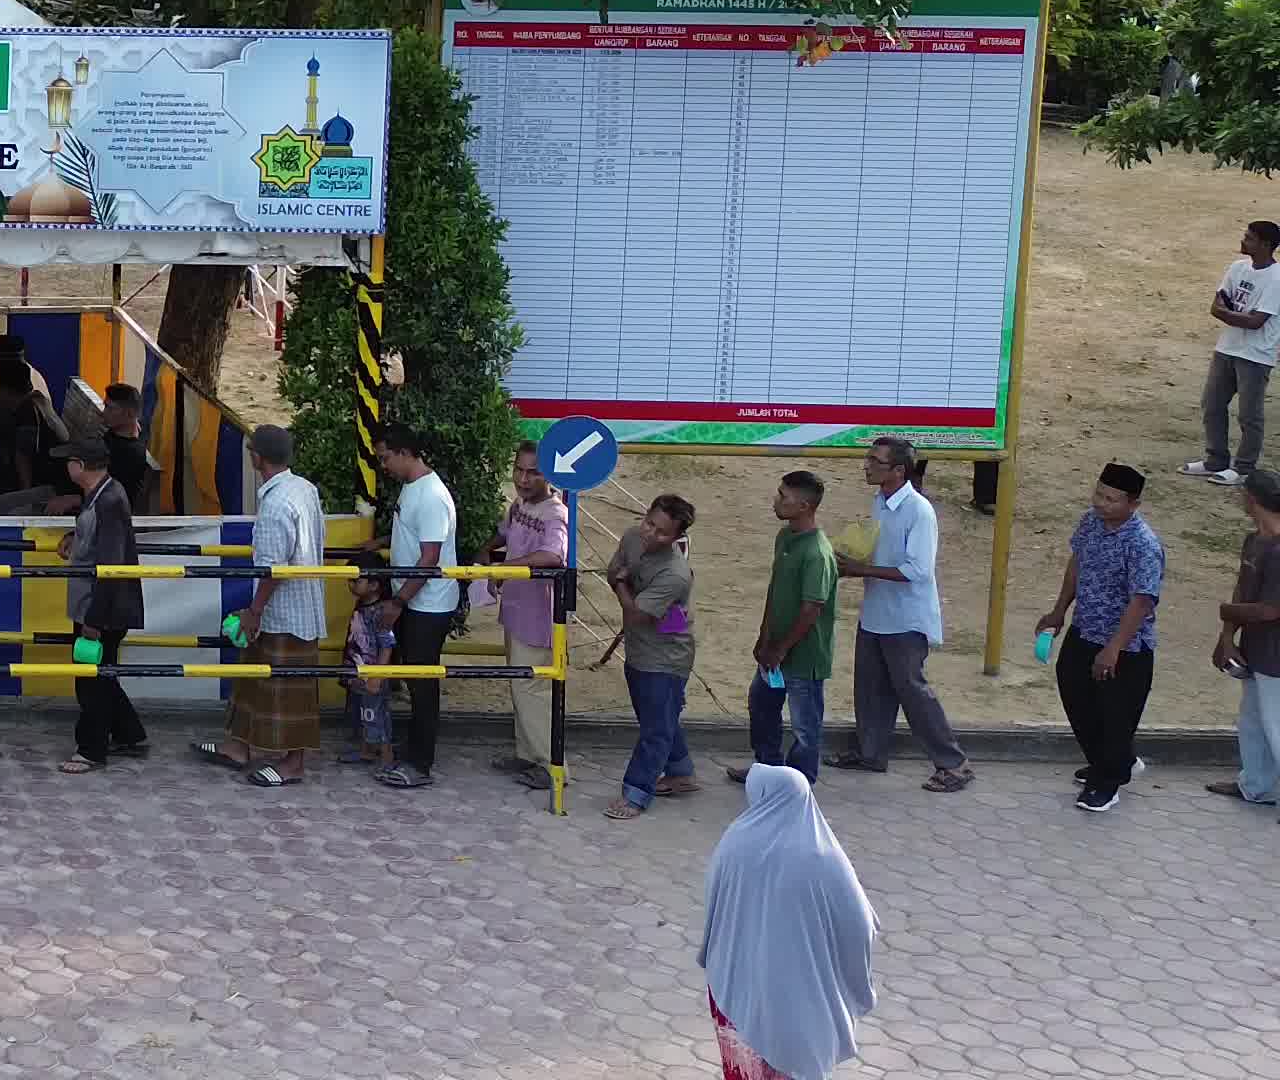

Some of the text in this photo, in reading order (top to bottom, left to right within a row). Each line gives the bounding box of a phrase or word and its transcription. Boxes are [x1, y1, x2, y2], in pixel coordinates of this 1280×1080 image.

[728, 0, 755, 9] 1445
[758, 0, 767, 9] H
[645, 39, 679, 47] BARANG
[932, 42, 966, 51] BARANG
[258, 203, 372, 217] ISLAMIC CENTRE
[736, 408, 799, 418] JUMLAH TOTAL
